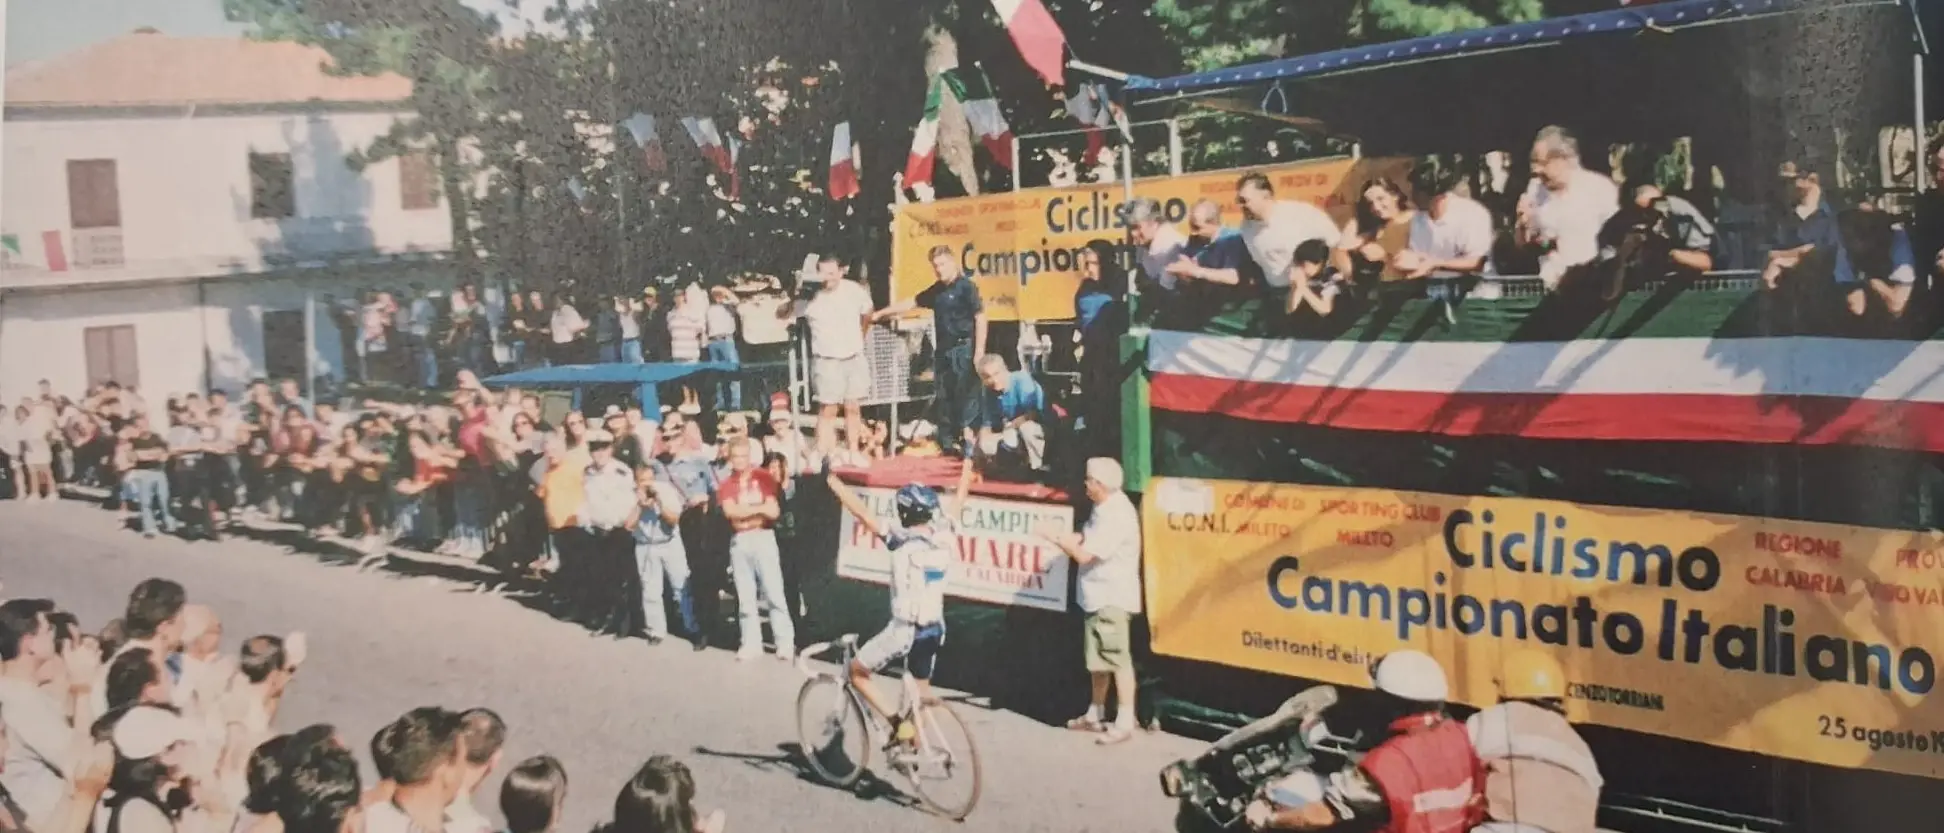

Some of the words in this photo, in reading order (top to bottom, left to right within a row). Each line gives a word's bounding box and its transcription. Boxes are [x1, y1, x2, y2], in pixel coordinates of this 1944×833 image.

[1046, 191, 1186, 233] Cicliso
[1443, 509, 1721, 591] Ciclismo
[1754, 531, 1842, 559] REGIONE
[1745, 565, 1846, 595] CALABRIA
[1241, 630, 1323, 658] Dilettanti
[1267, 555, 1645, 656] Campionato
[1657, 598, 1936, 695] Italiano
[1818, 714, 1847, 738] 25
[1852, 726, 1929, 752] agosto
